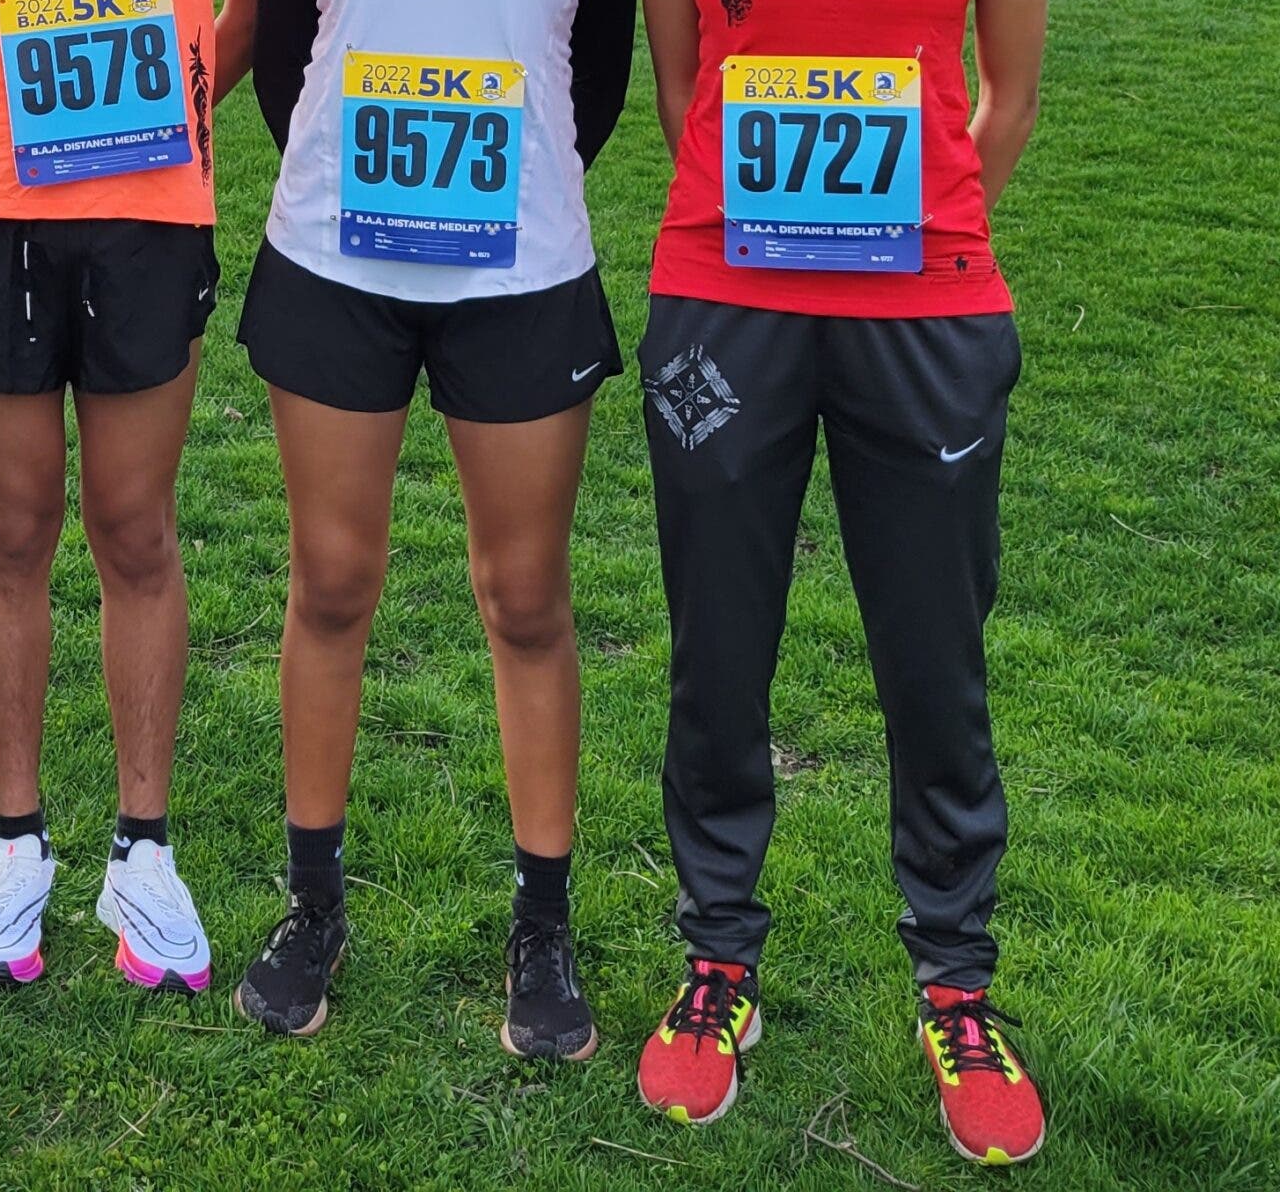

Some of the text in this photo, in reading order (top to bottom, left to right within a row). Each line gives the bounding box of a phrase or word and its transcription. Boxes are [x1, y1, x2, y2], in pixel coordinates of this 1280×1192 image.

[18, 12, 72, 29] B.A.A.
[16, 24, 172, 116] 9578
[362, 64, 411, 82] 2022
[745, 68, 797, 85] 2022
[362, 68, 471, 99] B.A.A. 5K
[745, 70, 863, 100] B.A.A. 5K
[31, 132, 155, 156] B.A.A. DISTANCE MEDLEY
[354, 104, 509, 193] 9573
[737, 110, 908, 195] 9727
[356, 215, 482, 233] B.A.A. DISTANCE MEDLEY
[743, 224, 882, 236] B.A.A. DISTANCE MEDLEY
